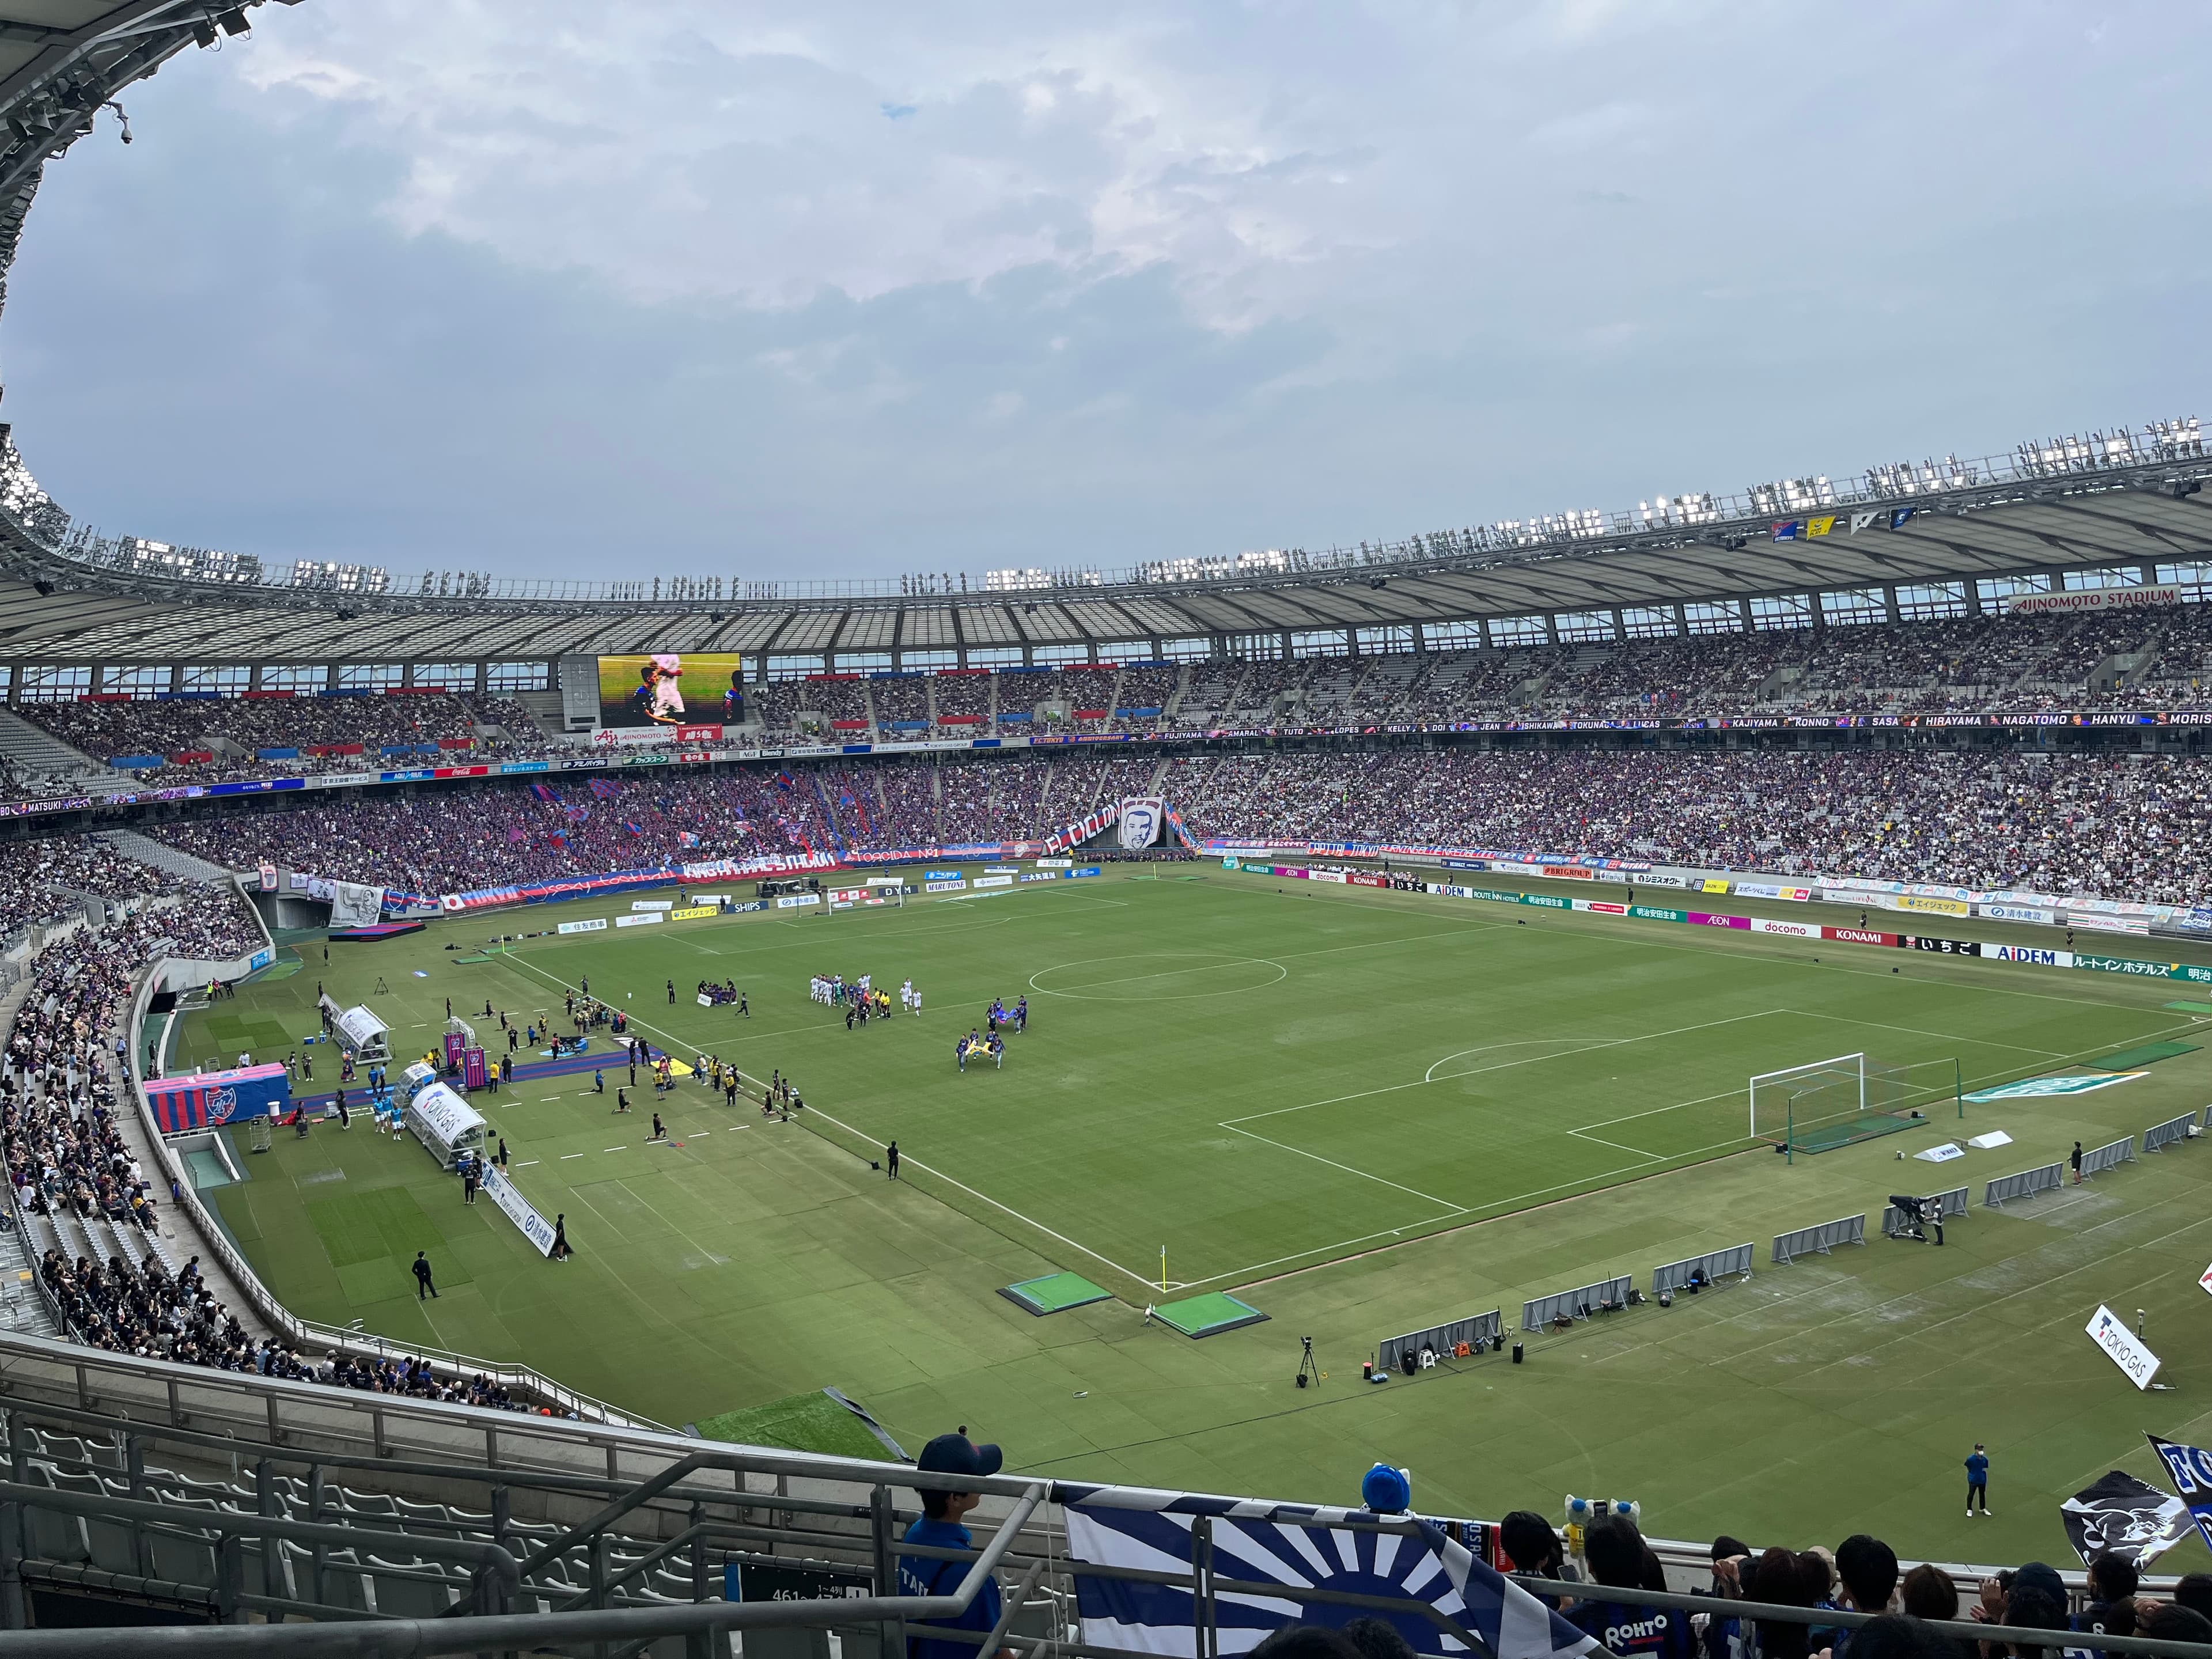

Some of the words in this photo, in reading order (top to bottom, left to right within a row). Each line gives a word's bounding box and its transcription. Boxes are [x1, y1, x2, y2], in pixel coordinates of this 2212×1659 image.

[2013, 594, 2101, 611] AJINOMOTO
[2108, 589, 2175, 605] STADIUM
[1732, 719, 1778, 728] KAJIYAMA
[1795, 718, 1829, 727] KONNO
[1872, 717, 1899, 726] SASA
[1926, 717, 1981, 726] HIRAYAMA
[2002, 715, 2067, 725] NAGATOMO
[2092, 715, 2135, 724] HANYU
[620, 733, 661, 741] AJINOMOTO
[1164, 732, 1202, 740] FUJIYAMA
[762, 749, 783, 757] Blendy
[573, 759, 606, 768] アミノバイタル
[635, 756, 668, 764] カップスープ
[29, 801, 60, 813] MATSUKI
[1350, 843, 1380, 857] TOKYO
[1619, 861, 1651, 870] MITAKA
[1316, 873, 1338, 882] docomo
[1353, 877, 1377, 887] KONAMI
[1644, 875, 1680, 885] シミズオクト
[927, 881, 965, 891] MARUTONE
[1397, 881, 1422, 892] いちご
[1737, 886, 1766, 895] スポーツくじ
[1474, 891, 1491, 899] ROUTE
[1528, 896, 1563, 907] 明治安田生命
[1916, 900, 1956, 911] エイジェック
[735, 902, 760, 912] SHIPS
[680, 908, 715, 917] エイジェック
[1637, 907, 1677, 920] 明治安田生命
[2006, 908, 2041, 921] 清水建設
[574, 921, 605, 930] 住友商事
[1765, 922, 1806, 935] docomo
[1836, 929, 1881, 944] KONAMI
[1921, 938, 1972, 955] いちご
[1998, 946, 2055, 965] AiDEM
[427, 1098, 446, 1122] TOKYO
[2104, 1330, 2130, 1361] TOKYO
[2128, 1354, 2147, 1378] GAS
[1469, 1524, 1482, 1559] OSA
[1604, 1614, 1668, 1649] ROHTO
